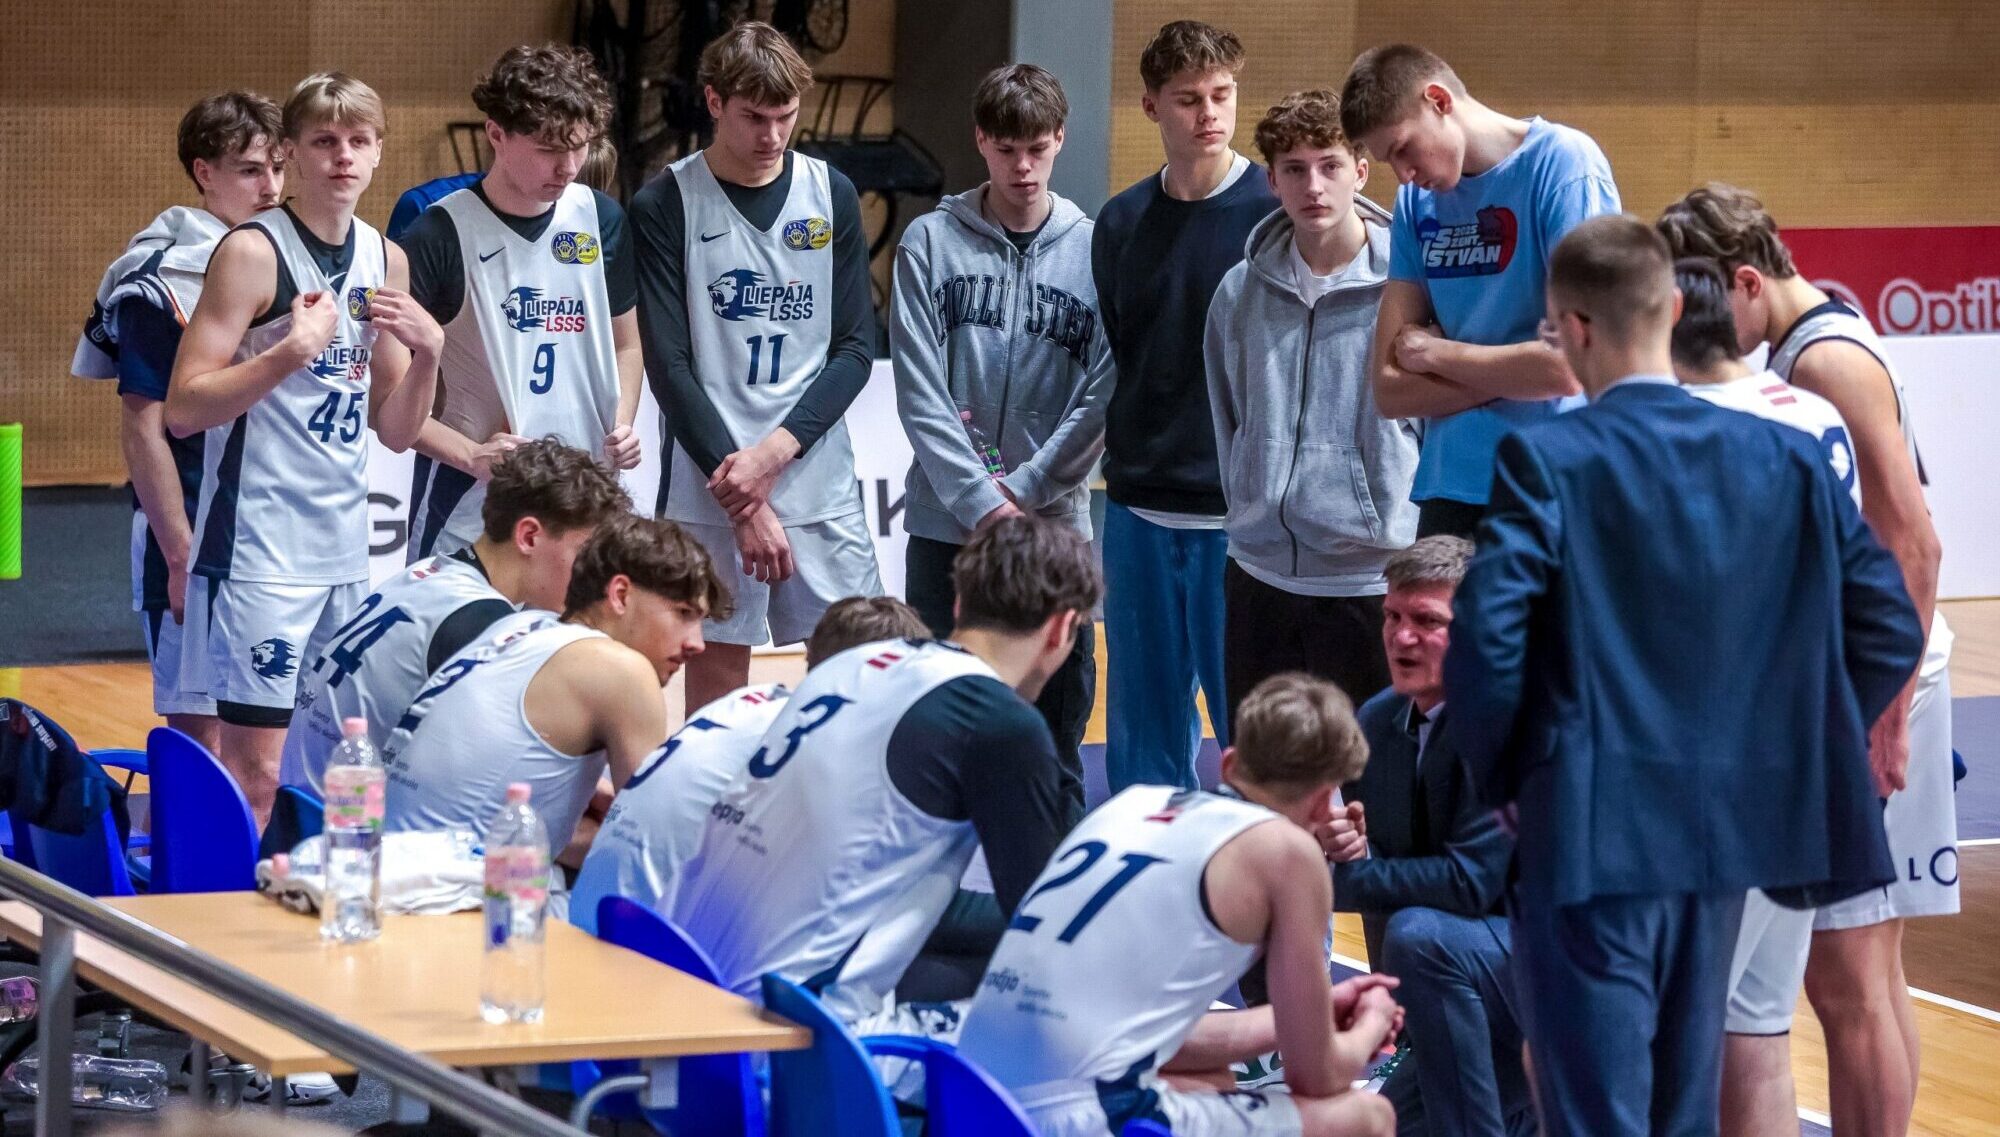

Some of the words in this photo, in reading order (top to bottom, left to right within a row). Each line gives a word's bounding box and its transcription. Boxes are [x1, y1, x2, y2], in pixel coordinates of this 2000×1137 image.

[526, 296, 585, 319] LIEPĀJA
[744, 280, 813, 305] LIEPĀJA
[769, 302, 814, 321] LSSS
[546, 316, 586, 333] LSSS
[529, 342, 560, 395] 9
[746, 333, 789, 385] 11
[307, 391, 367, 444] 45
[748, 694, 856, 779] 3
[1008, 840, 1173, 944] 21
